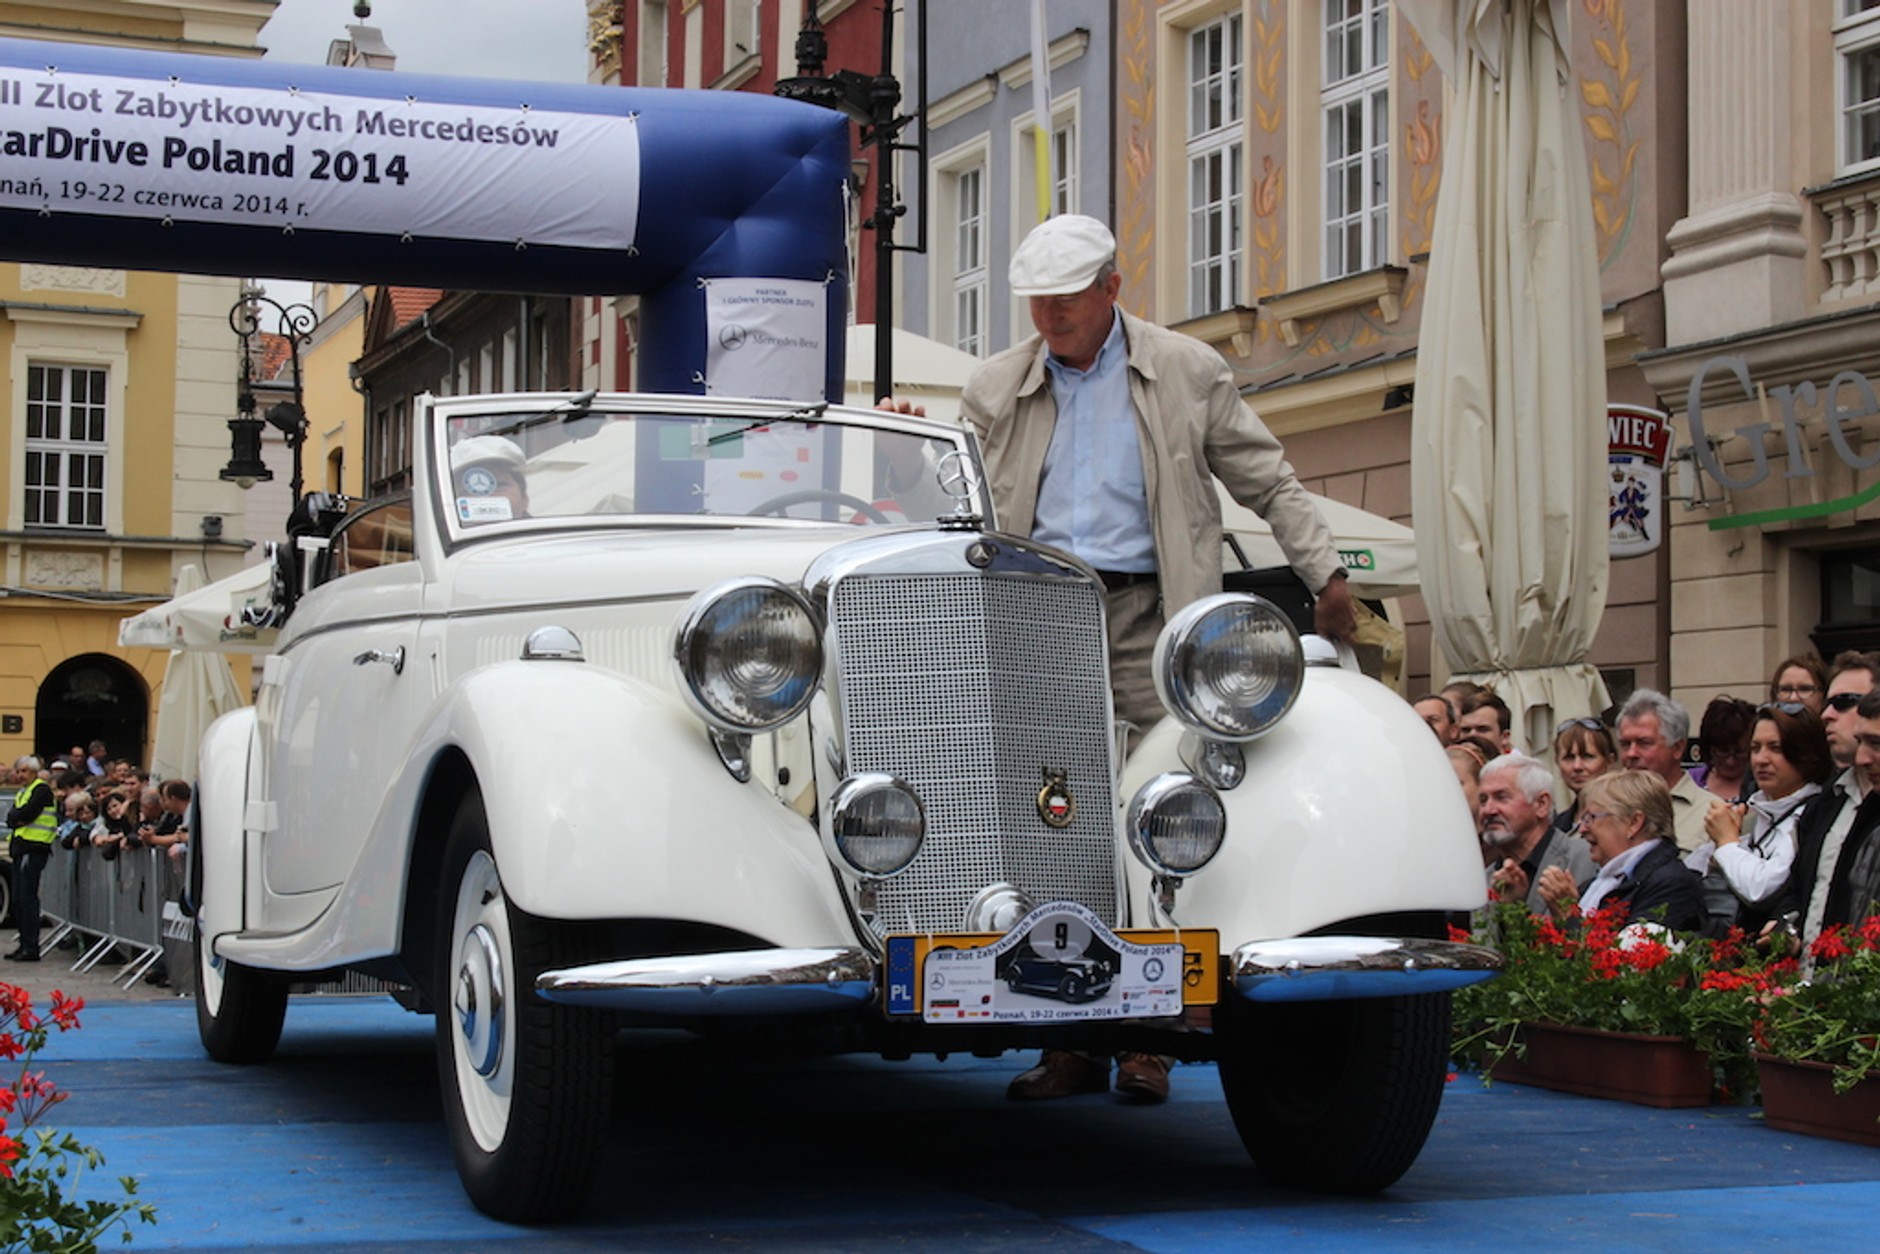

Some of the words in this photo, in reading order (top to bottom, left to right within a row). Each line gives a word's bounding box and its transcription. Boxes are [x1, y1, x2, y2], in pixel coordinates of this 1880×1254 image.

[35, 82, 103, 113] Zlot
[115, 89, 343, 137] Zabytkowych
[356, 109, 559, 148] Mercedesów
[0, 126, 148, 167] arDrive
[163, 136, 294, 178] Poland
[310, 148, 409, 186] 2014
[61, 180, 125, 203] 19-22
[134, 189, 223, 211] czerwca
[233, 194, 288, 215] 2014
[297, 202, 309, 217] r.
[755, 288, 787, 296] PARTNER
[761, 296, 794, 305] SPONSOR
[1687, 355, 1880, 490] Gre
[1055, 922, 1068, 950] 9
[955, 951, 973, 961] Zlot
[1120, 943, 1149, 956] Poland
[890, 984, 911, 1001] PL
[1092, 1007, 1112, 1017] 2014
